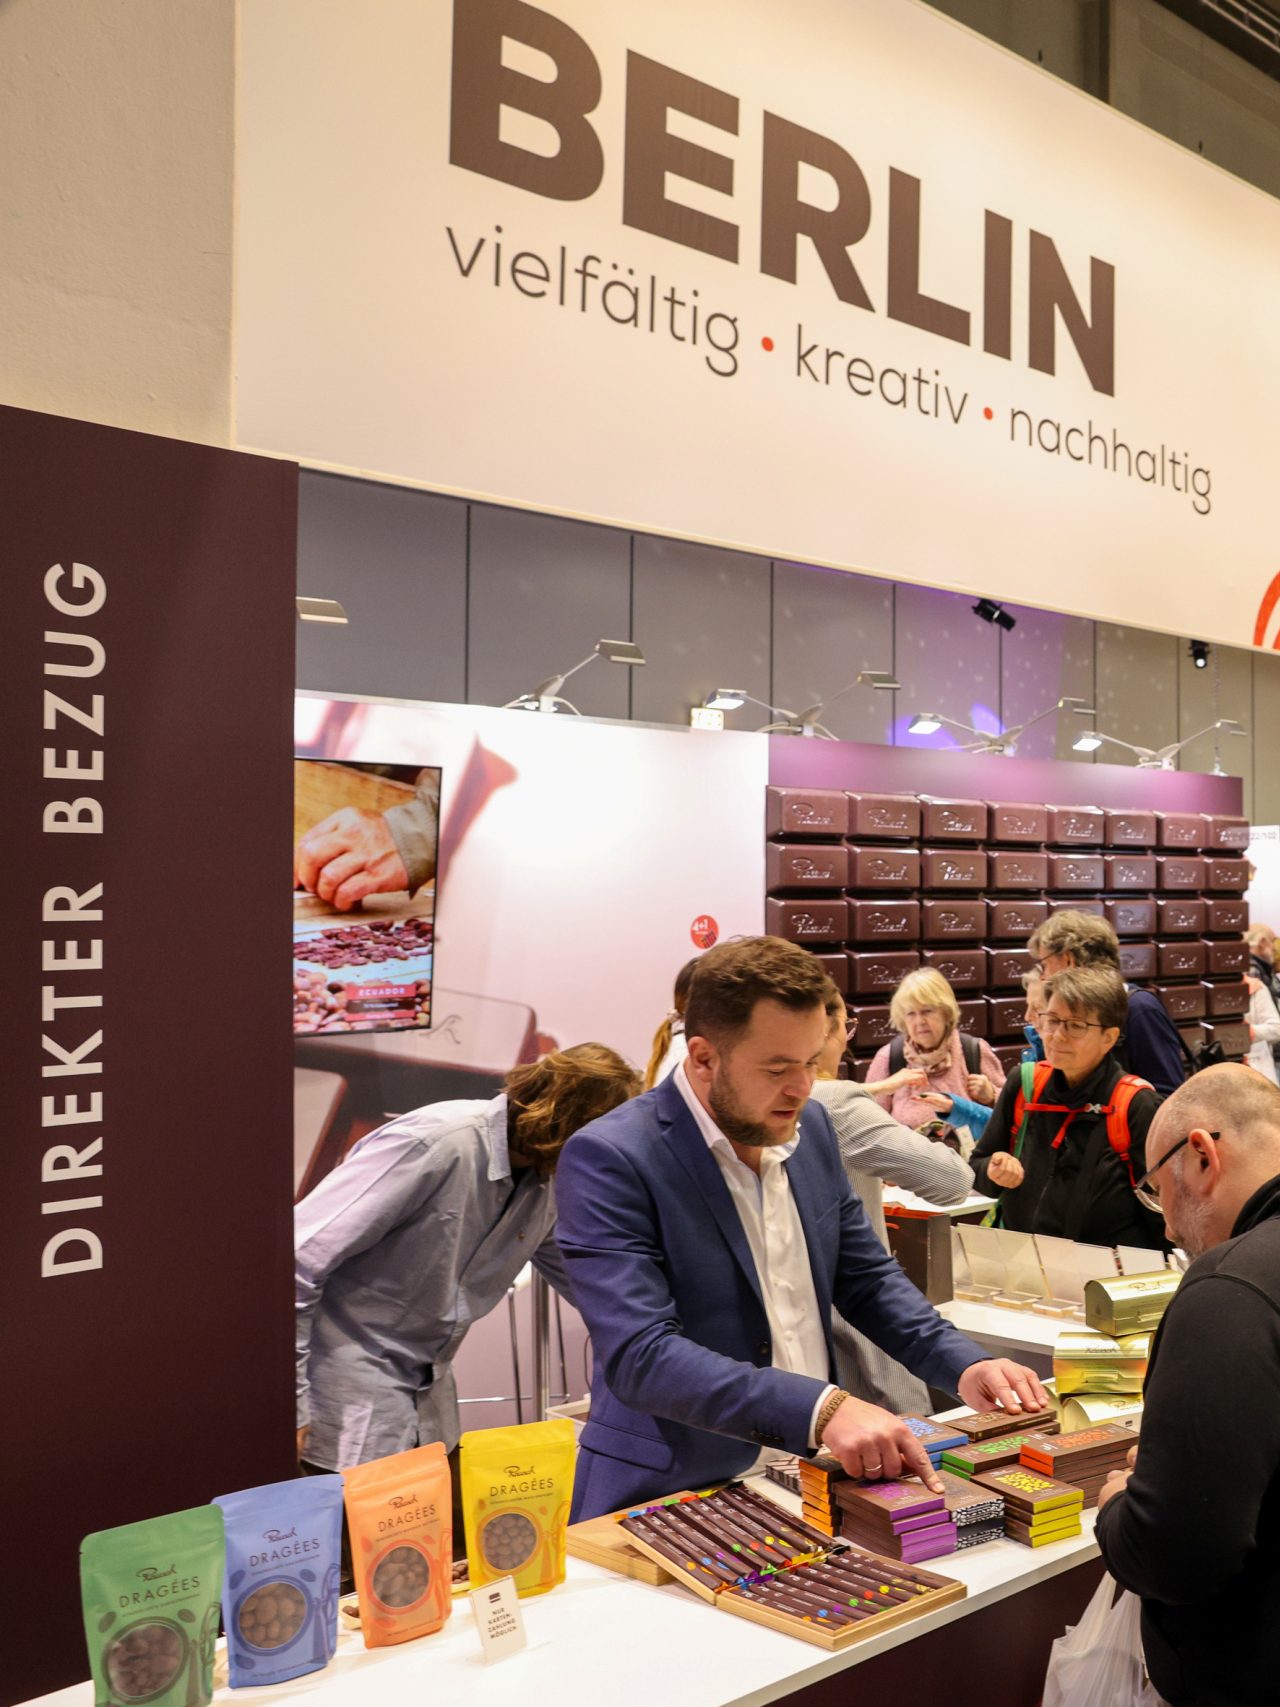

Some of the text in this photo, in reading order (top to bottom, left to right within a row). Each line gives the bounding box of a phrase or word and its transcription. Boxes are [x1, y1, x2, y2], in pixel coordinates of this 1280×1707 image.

[447, 0, 1116, 398] BERLIN
[445, 225, 1213, 515] vielfältig kreativ nachhaltig
[41, 561, 107, 1278] DIREKTER BEZUG
[358, 987, 405, 996] ECUADOR
[489, 1478, 554, 1497] DRAGÉES
[378, 1503, 437, 1533] DRAGÉES
[249, 1538, 321, 1567] DRAGÉES
[119, 1576, 200, 1608] DRAGÉES
